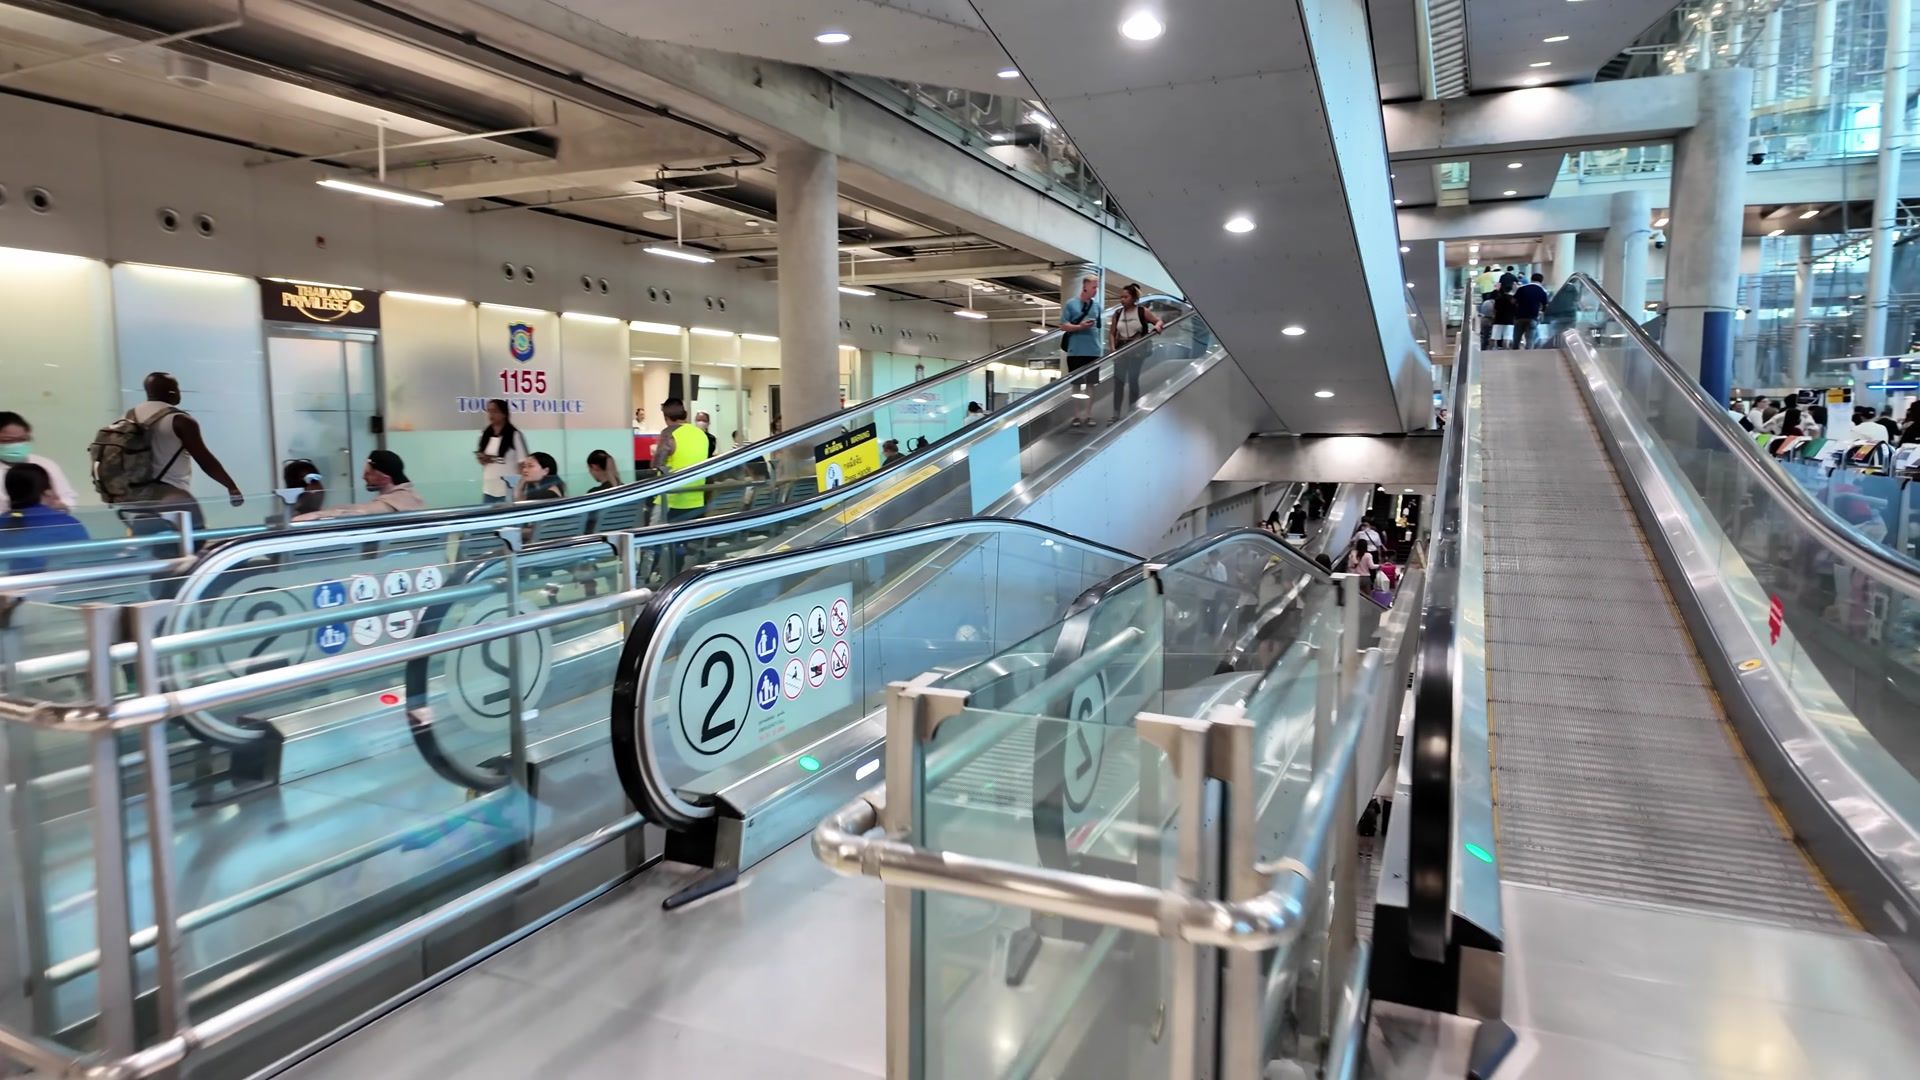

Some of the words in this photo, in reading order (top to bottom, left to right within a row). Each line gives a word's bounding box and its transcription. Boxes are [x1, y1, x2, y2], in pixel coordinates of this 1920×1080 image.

[282, 292, 348, 311] PRIVILEGE
[295, 285, 352, 300] THAILAND
[500, 370, 546, 394] 1155
[457, 398, 527, 412] TOUST
[533, 400, 584, 413] POLICE
[701, 650, 735, 743] 2
